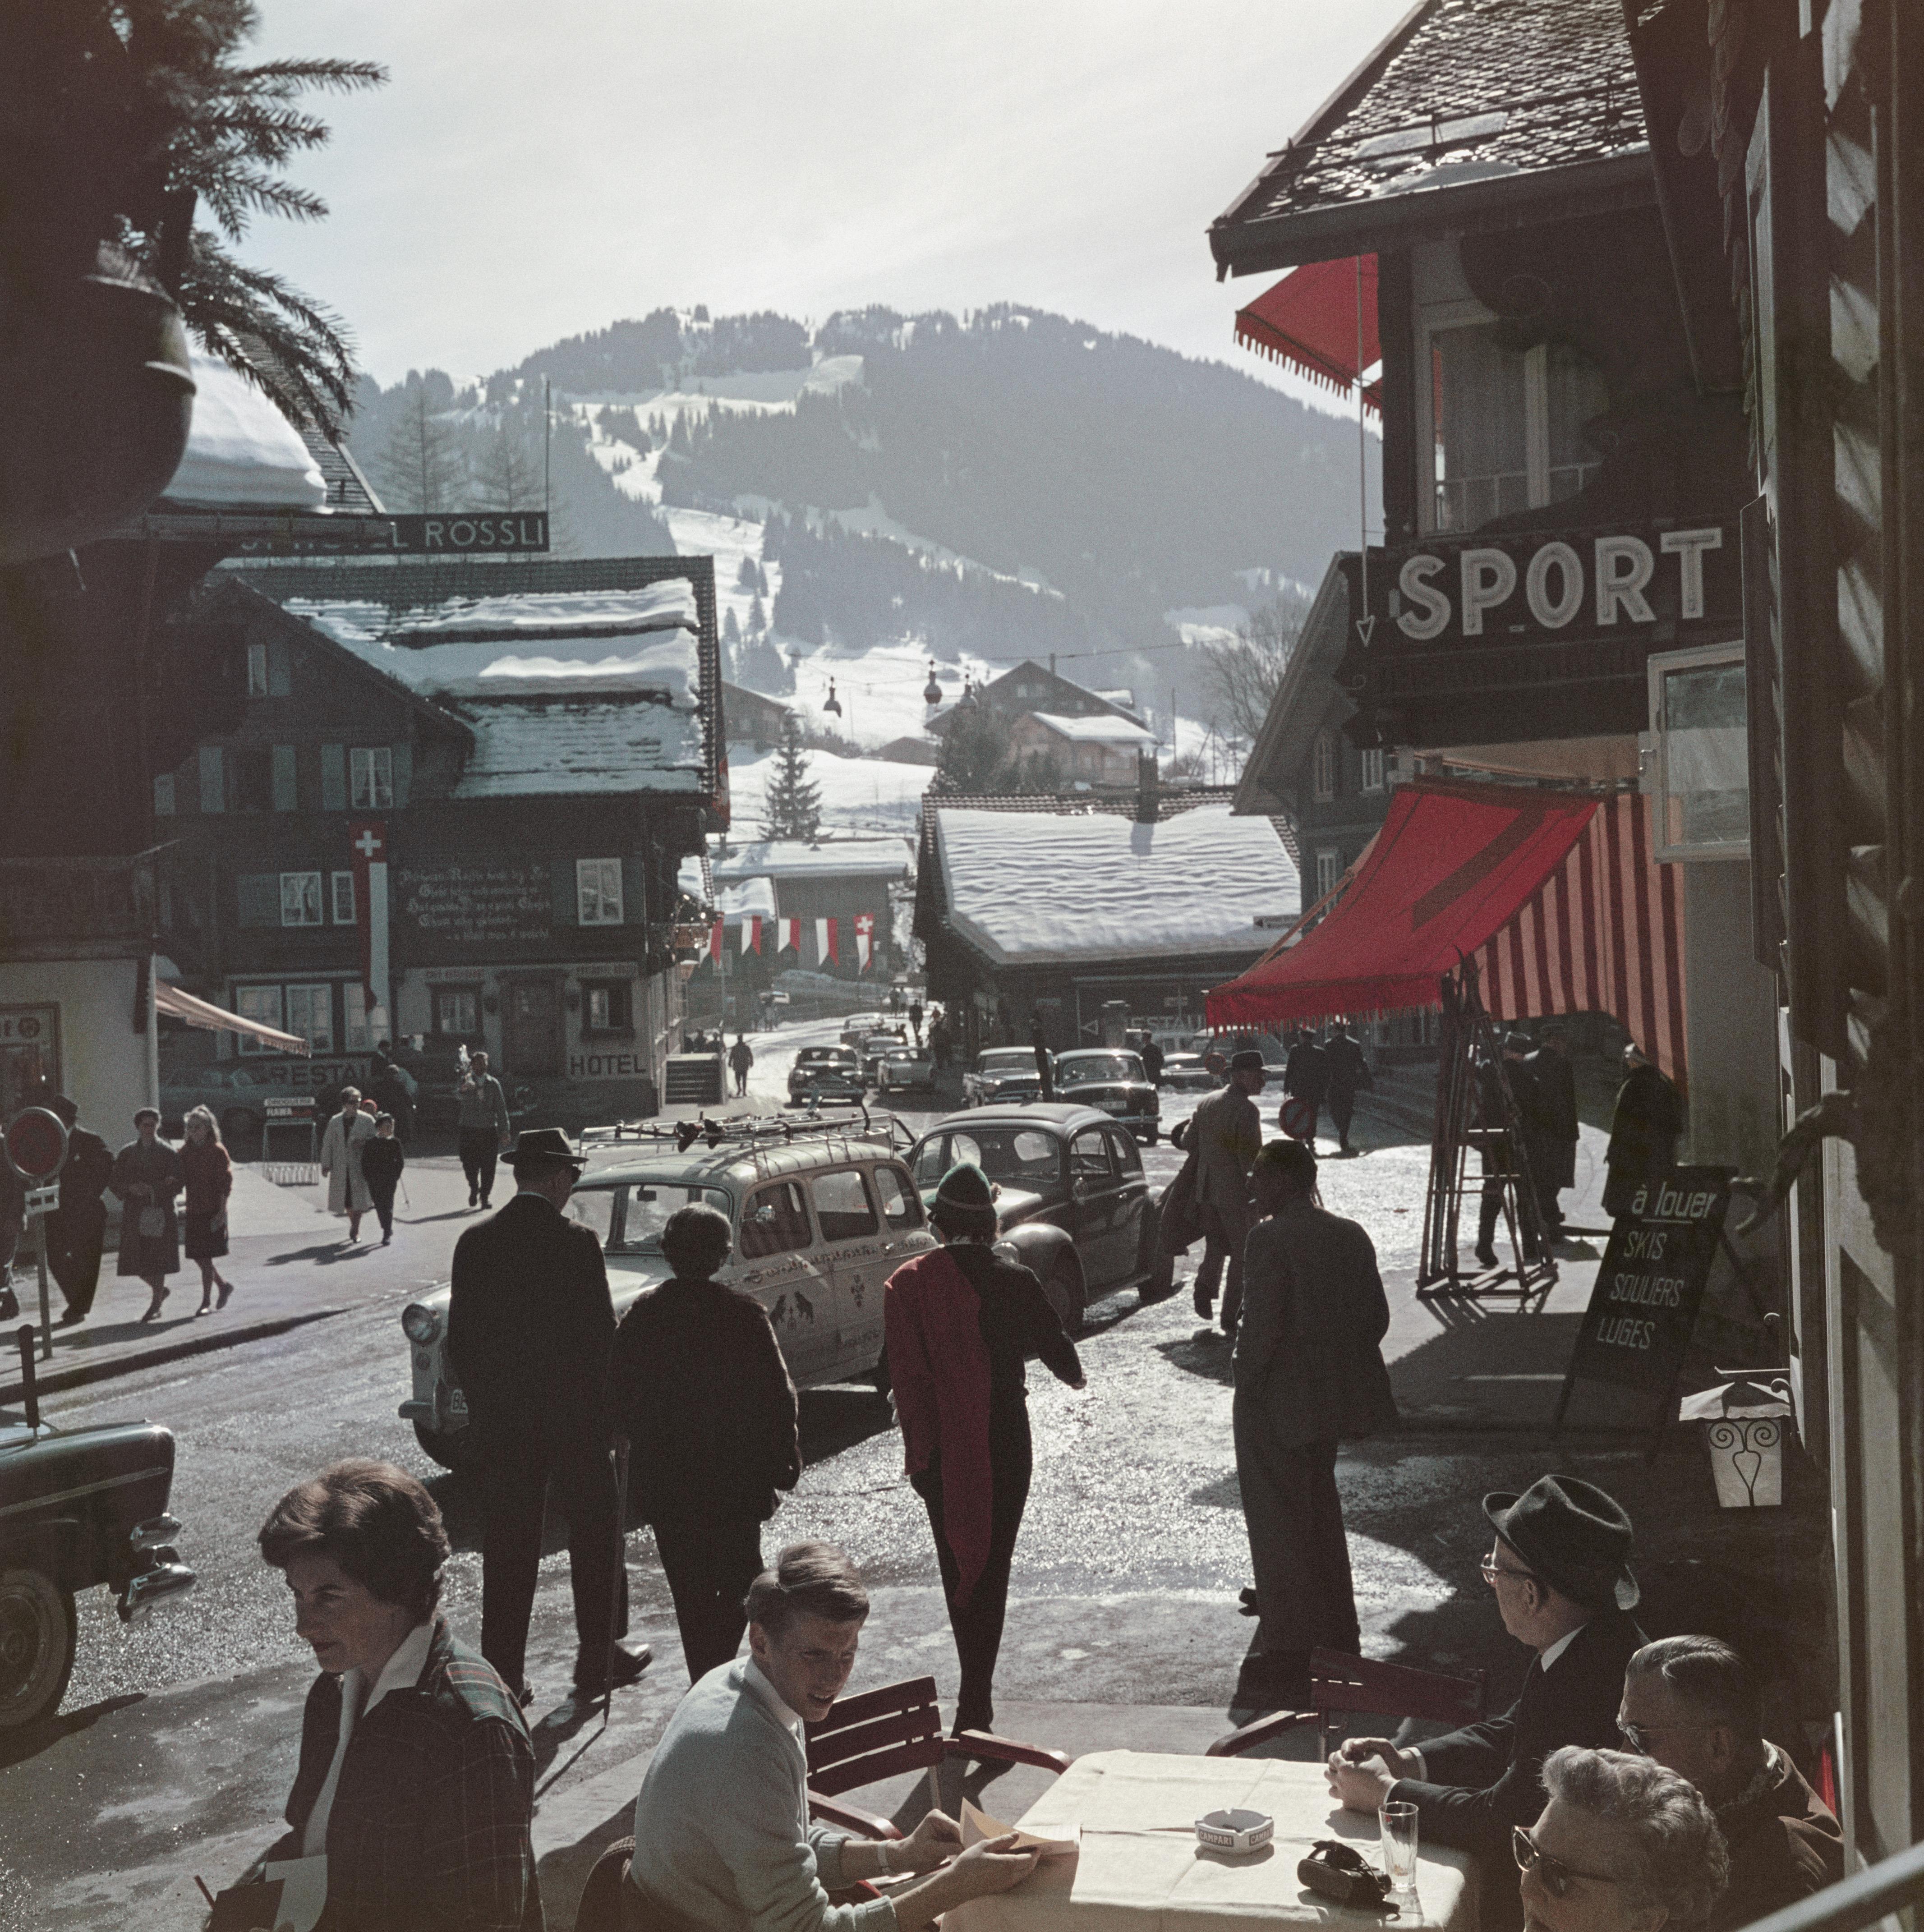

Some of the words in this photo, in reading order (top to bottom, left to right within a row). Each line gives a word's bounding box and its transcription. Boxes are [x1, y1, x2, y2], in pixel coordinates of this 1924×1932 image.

[425, 519, 543, 547] RÖSSLI
[1396, 527, 1723, 640] SPORT
[571, 1054, 646, 1075] HOTEL
[1631, 1184, 1648, 1214] à
[1654, 1181, 1717, 1219] louer
[1624, 1231, 1668, 1260] SKIS
[1610, 1273, 1685, 1307] SOULIERS
[1597, 1317, 1655, 1350] LUGES
[1199, 1831, 1232, 1845] CAMPARI
